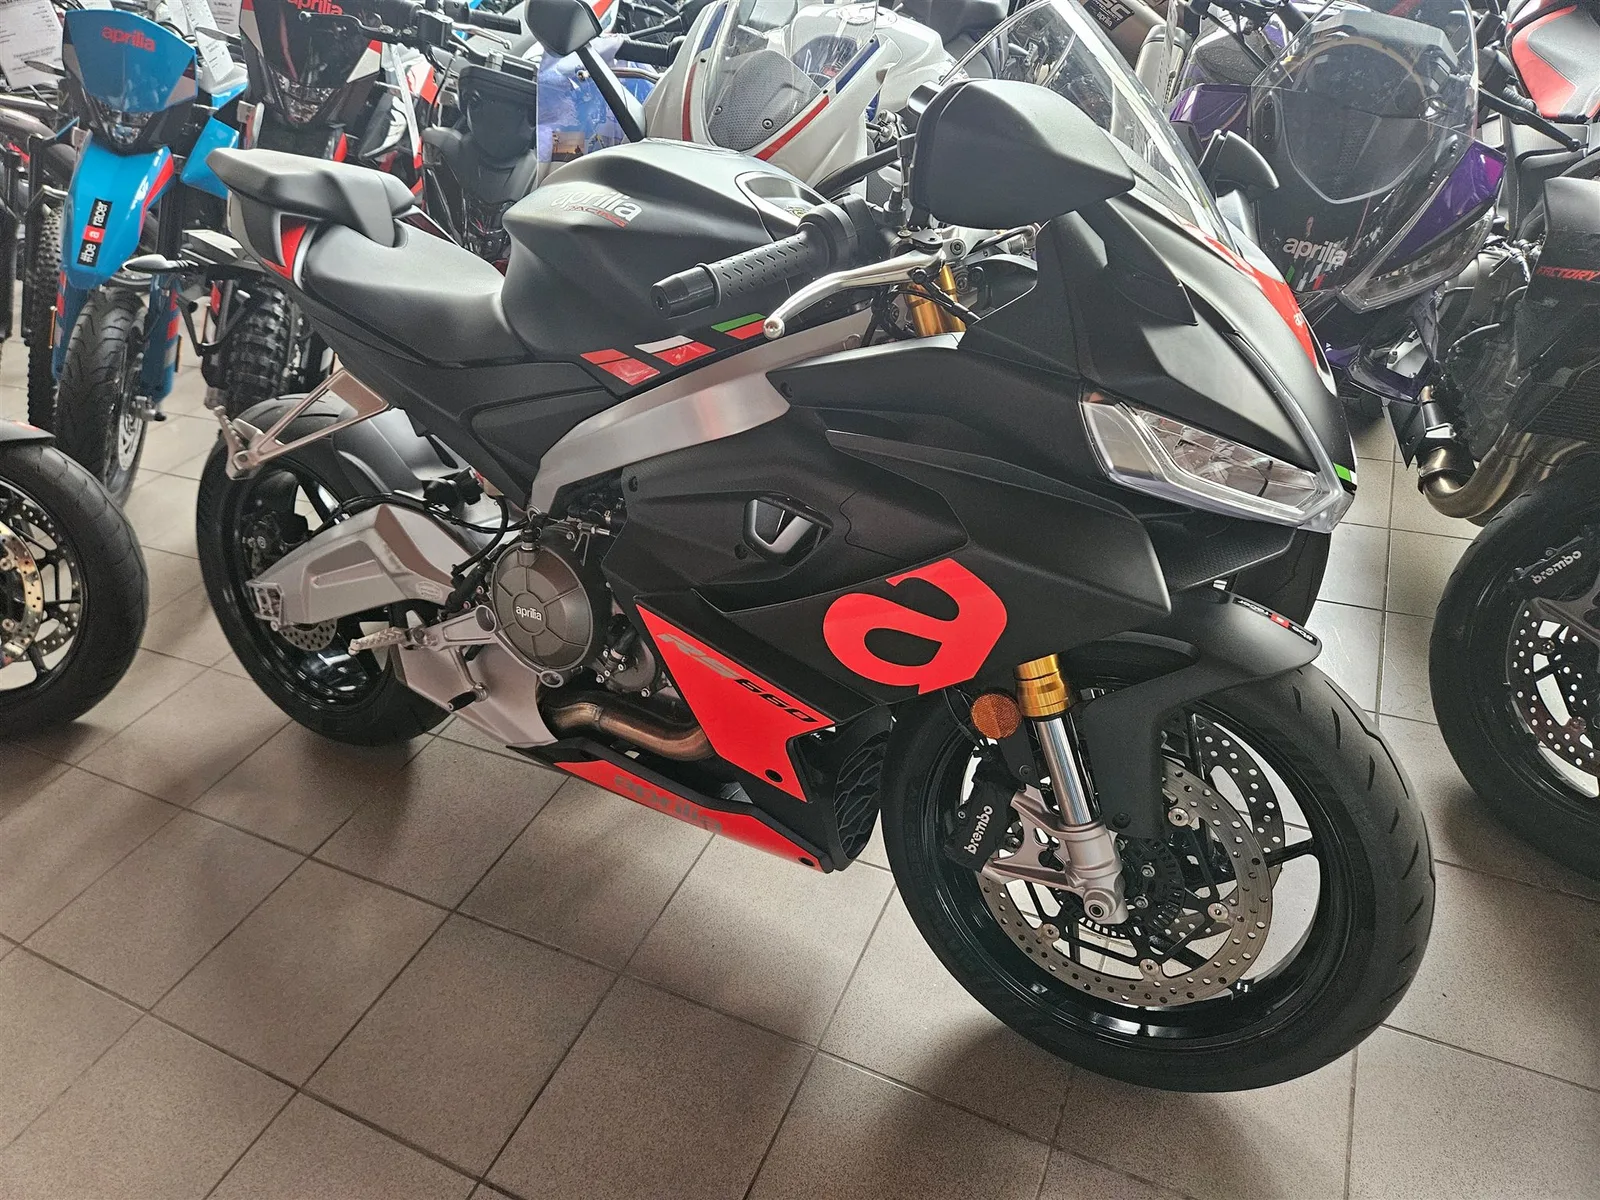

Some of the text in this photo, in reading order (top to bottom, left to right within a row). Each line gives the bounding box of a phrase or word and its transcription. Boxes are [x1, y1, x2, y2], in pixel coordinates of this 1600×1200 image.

[101, 26, 156, 52] aprilia
[92, 201, 109, 227] racer
[551, 191, 642, 222] aprilia
[88, 230, 100, 239] a
[1282, 237, 1349, 267] aprilia
[1530, 550, 1582, 585] brembo
[515, 605, 542, 621] aprilia
[823, 557, 1008, 695] a
[613, 774, 723, 834] aprilia
[963, 805, 993, 855] brembo
